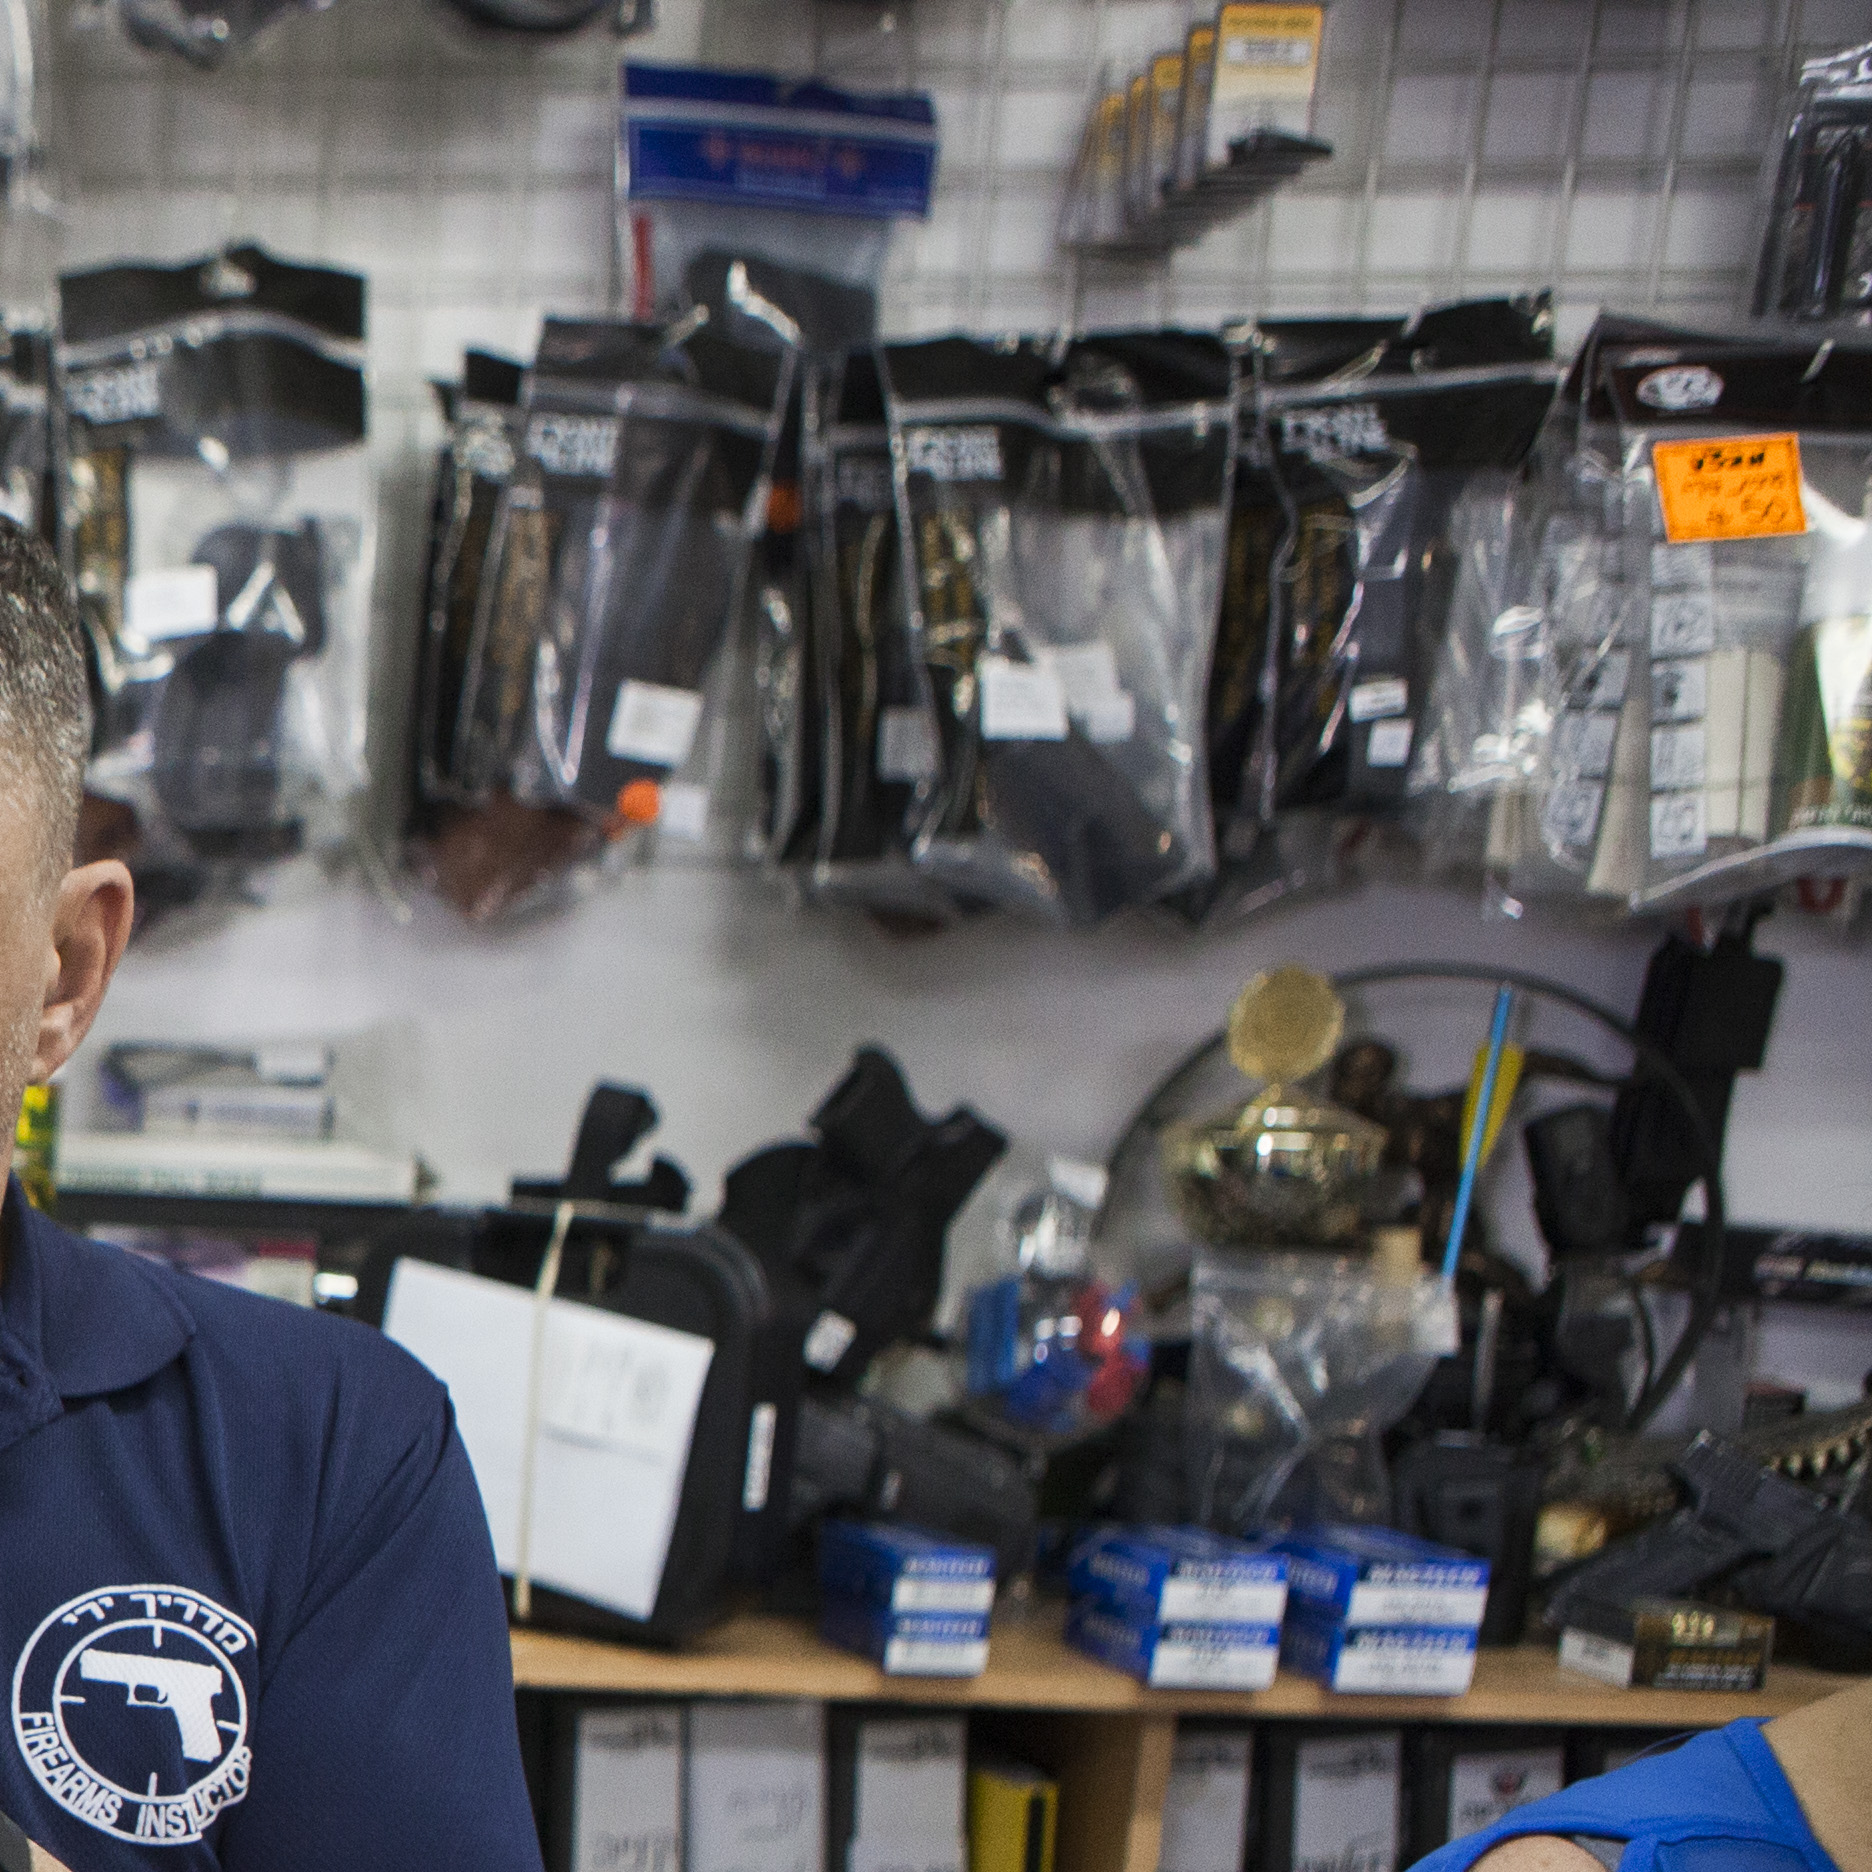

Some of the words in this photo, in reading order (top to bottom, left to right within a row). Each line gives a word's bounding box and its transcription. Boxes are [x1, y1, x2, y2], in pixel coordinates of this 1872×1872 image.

[61, 1595, 115, 1626] ירי
[129, 1592, 248, 1655] מדריך
[19, 1711, 123, 1827] FIREARMS
